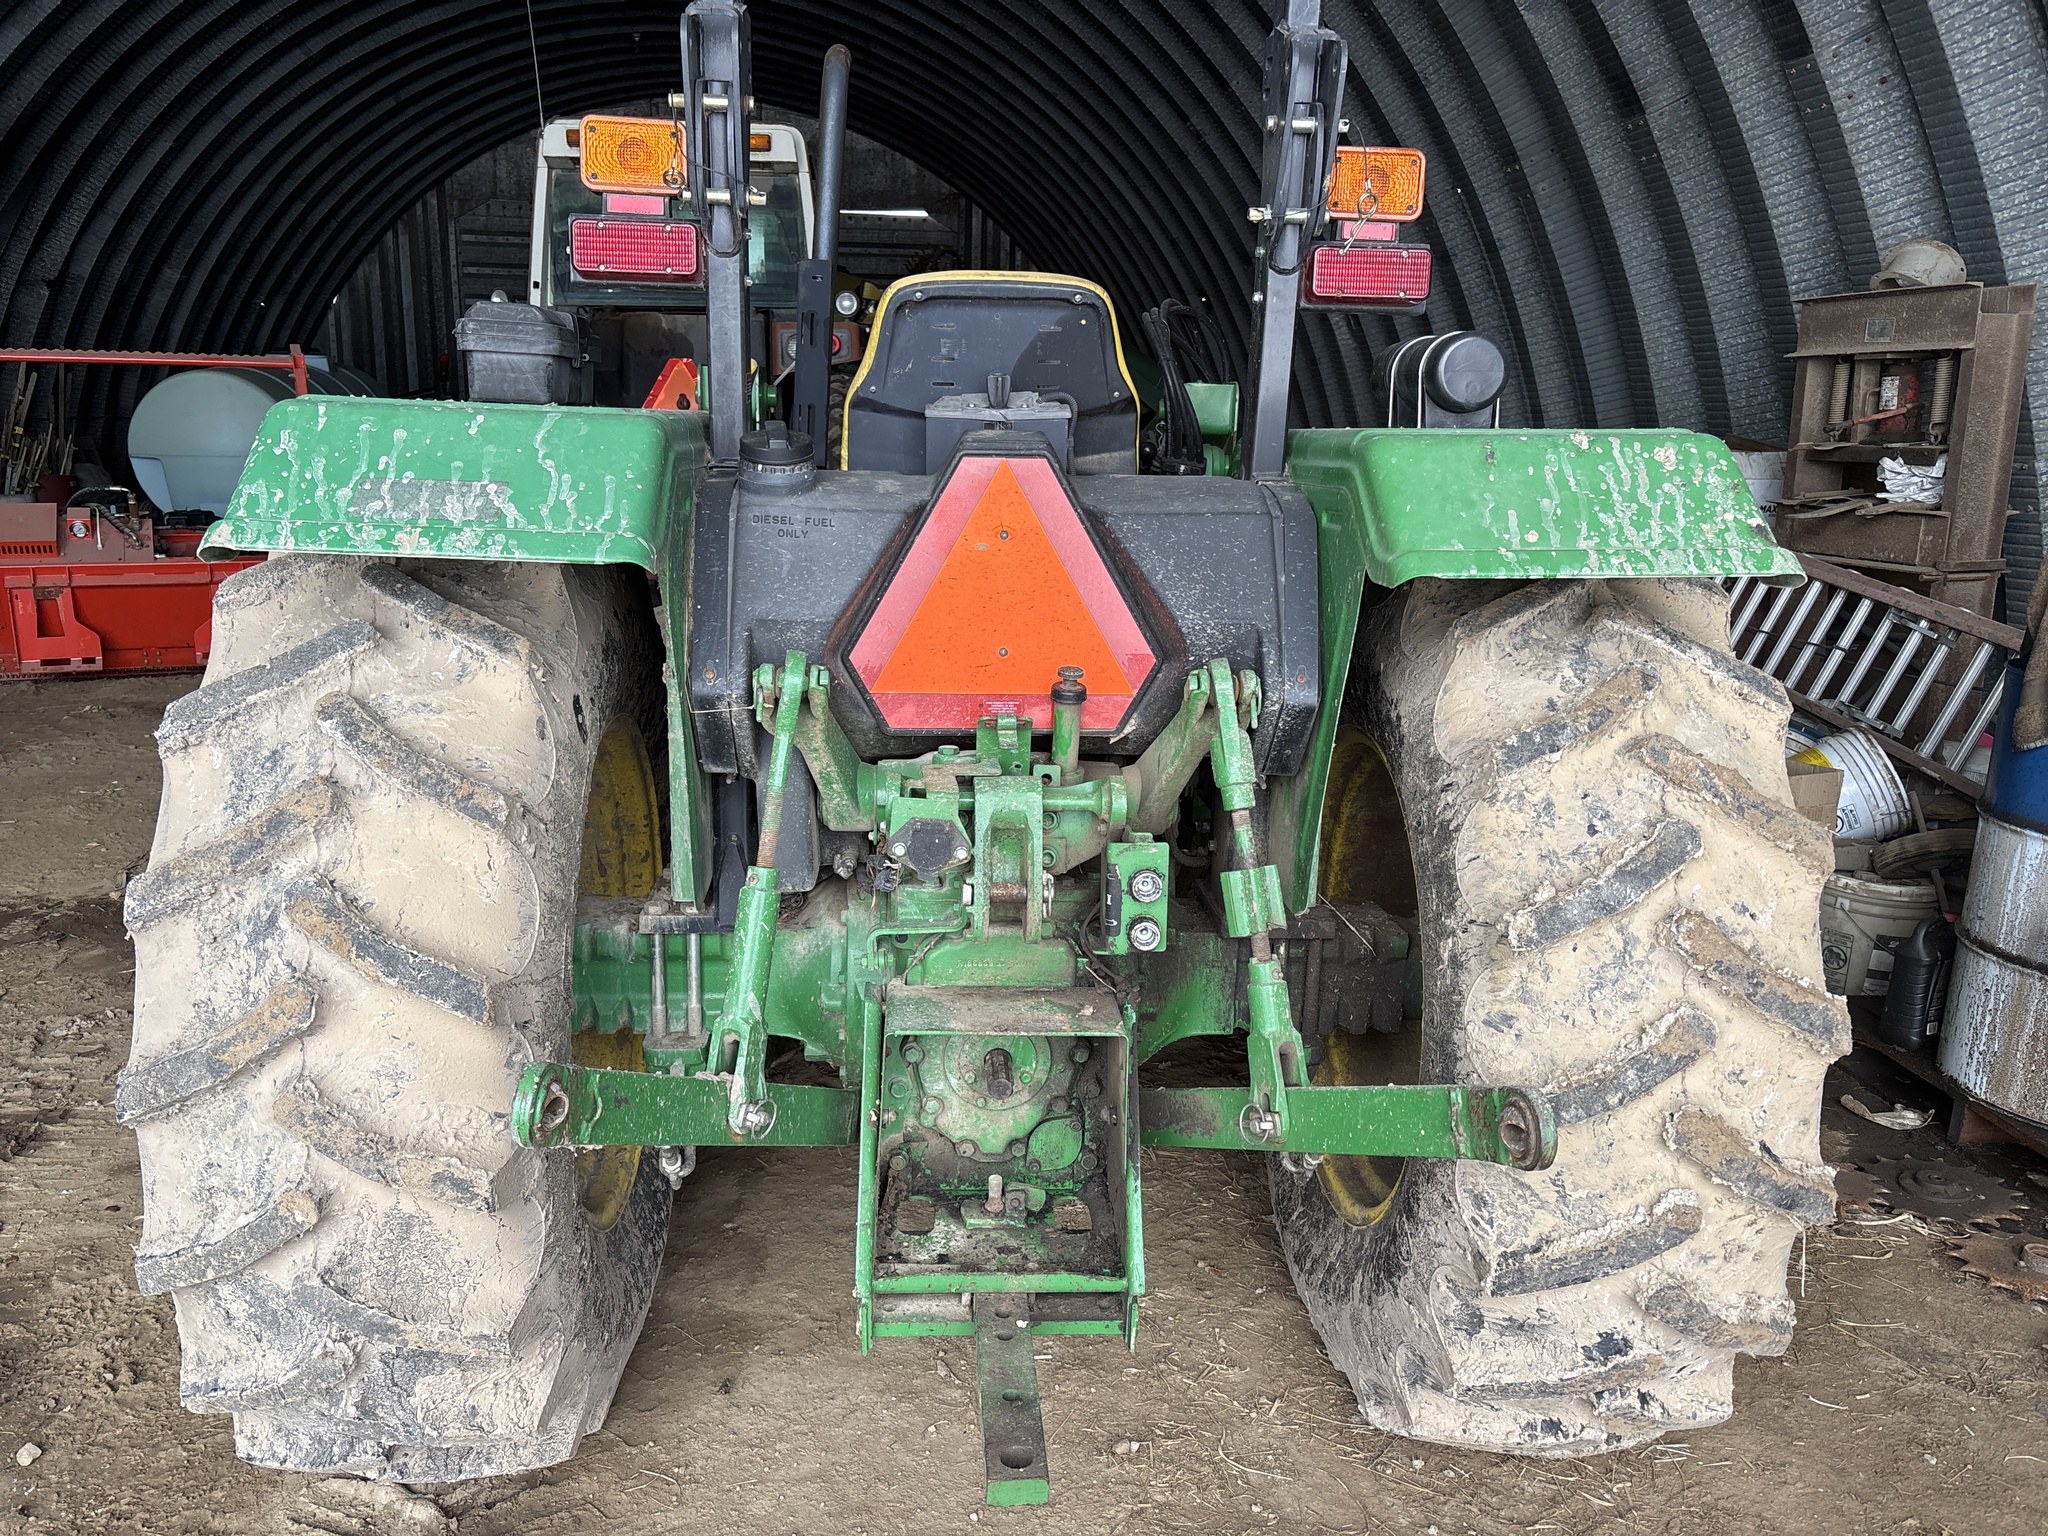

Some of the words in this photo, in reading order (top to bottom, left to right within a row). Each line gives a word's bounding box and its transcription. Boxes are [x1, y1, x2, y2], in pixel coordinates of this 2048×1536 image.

[752, 514, 794, 525] DIESEL
[804, 517, 835, 527] FUEL
[777, 529, 808, 538] ONLY
